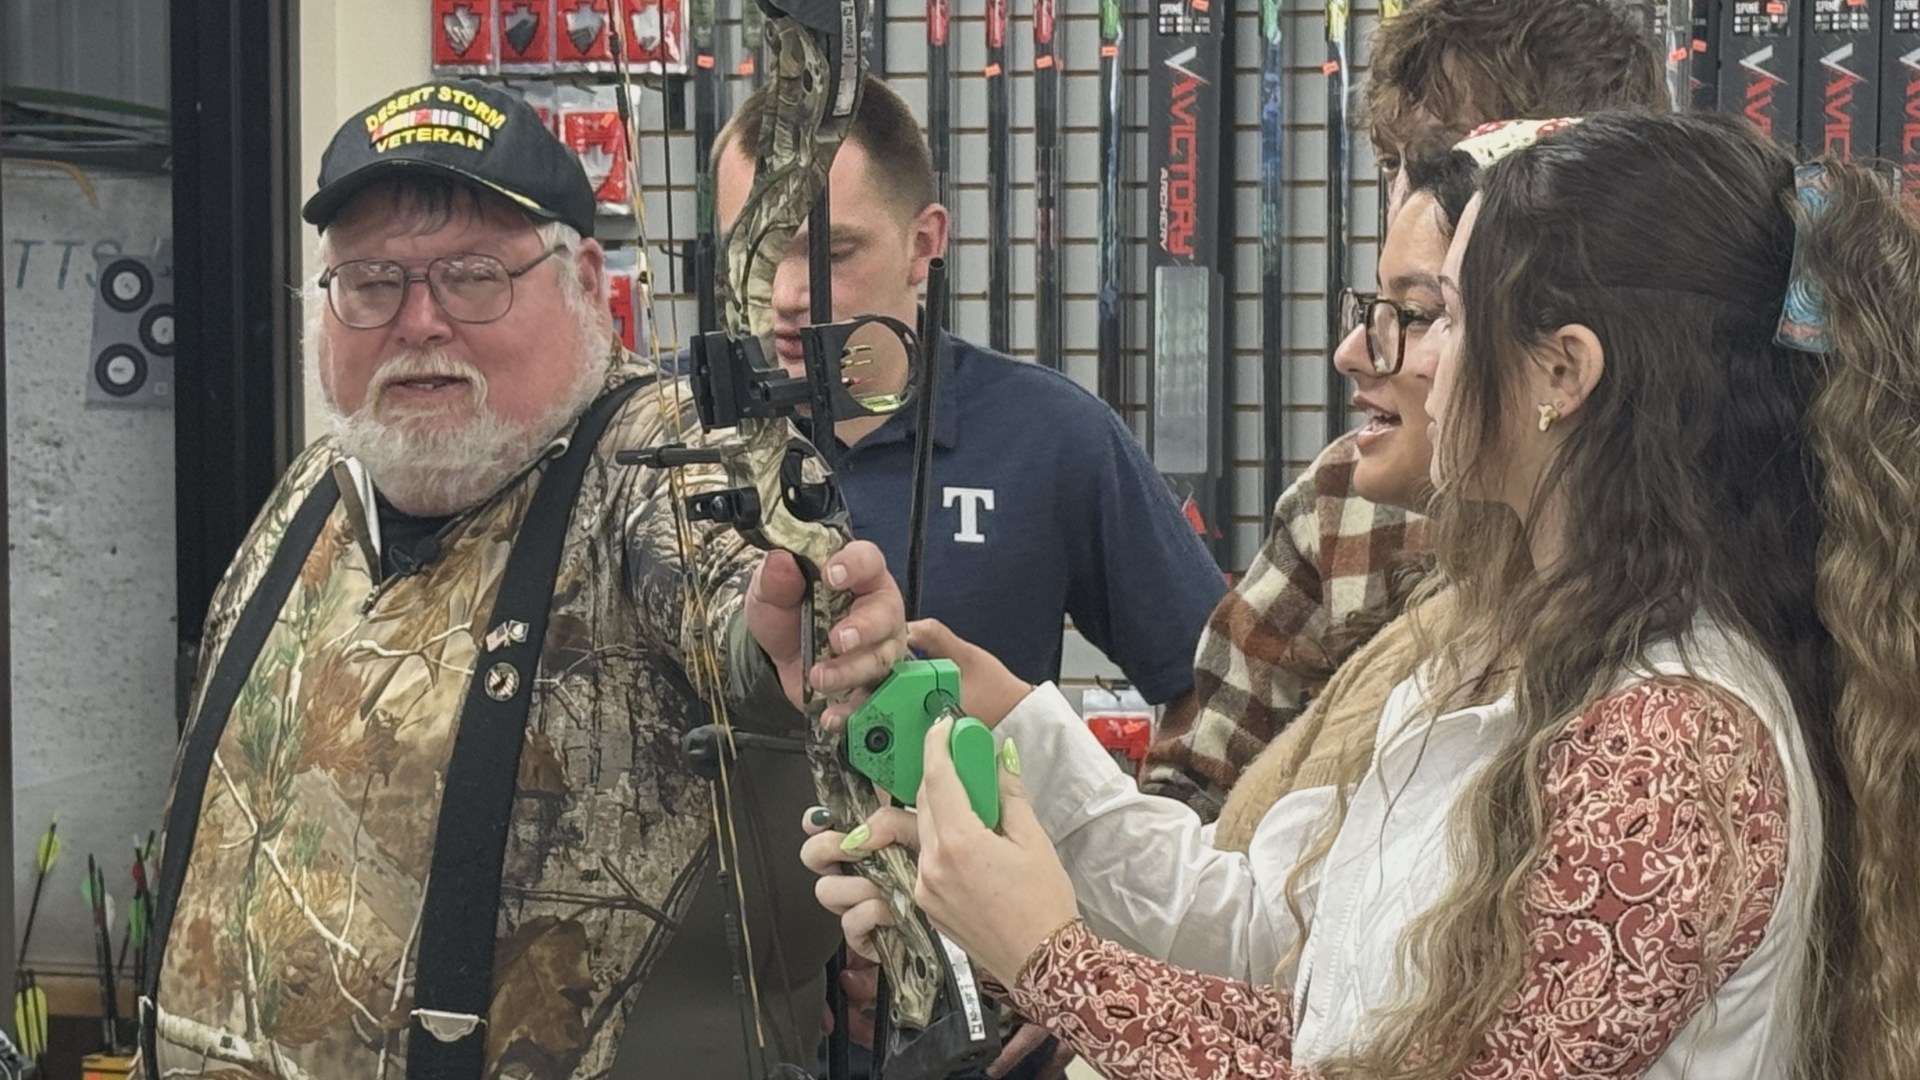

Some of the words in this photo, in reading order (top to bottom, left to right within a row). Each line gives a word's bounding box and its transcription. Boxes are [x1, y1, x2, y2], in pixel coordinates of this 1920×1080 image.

[365, 86, 435, 133] DESERT
[438, 86, 507, 130] STORM
[376, 127, 484, 153] VETERAN
[1160, 167, 1168, 252] ARCHERY
[943, 486, 995, 544] T
